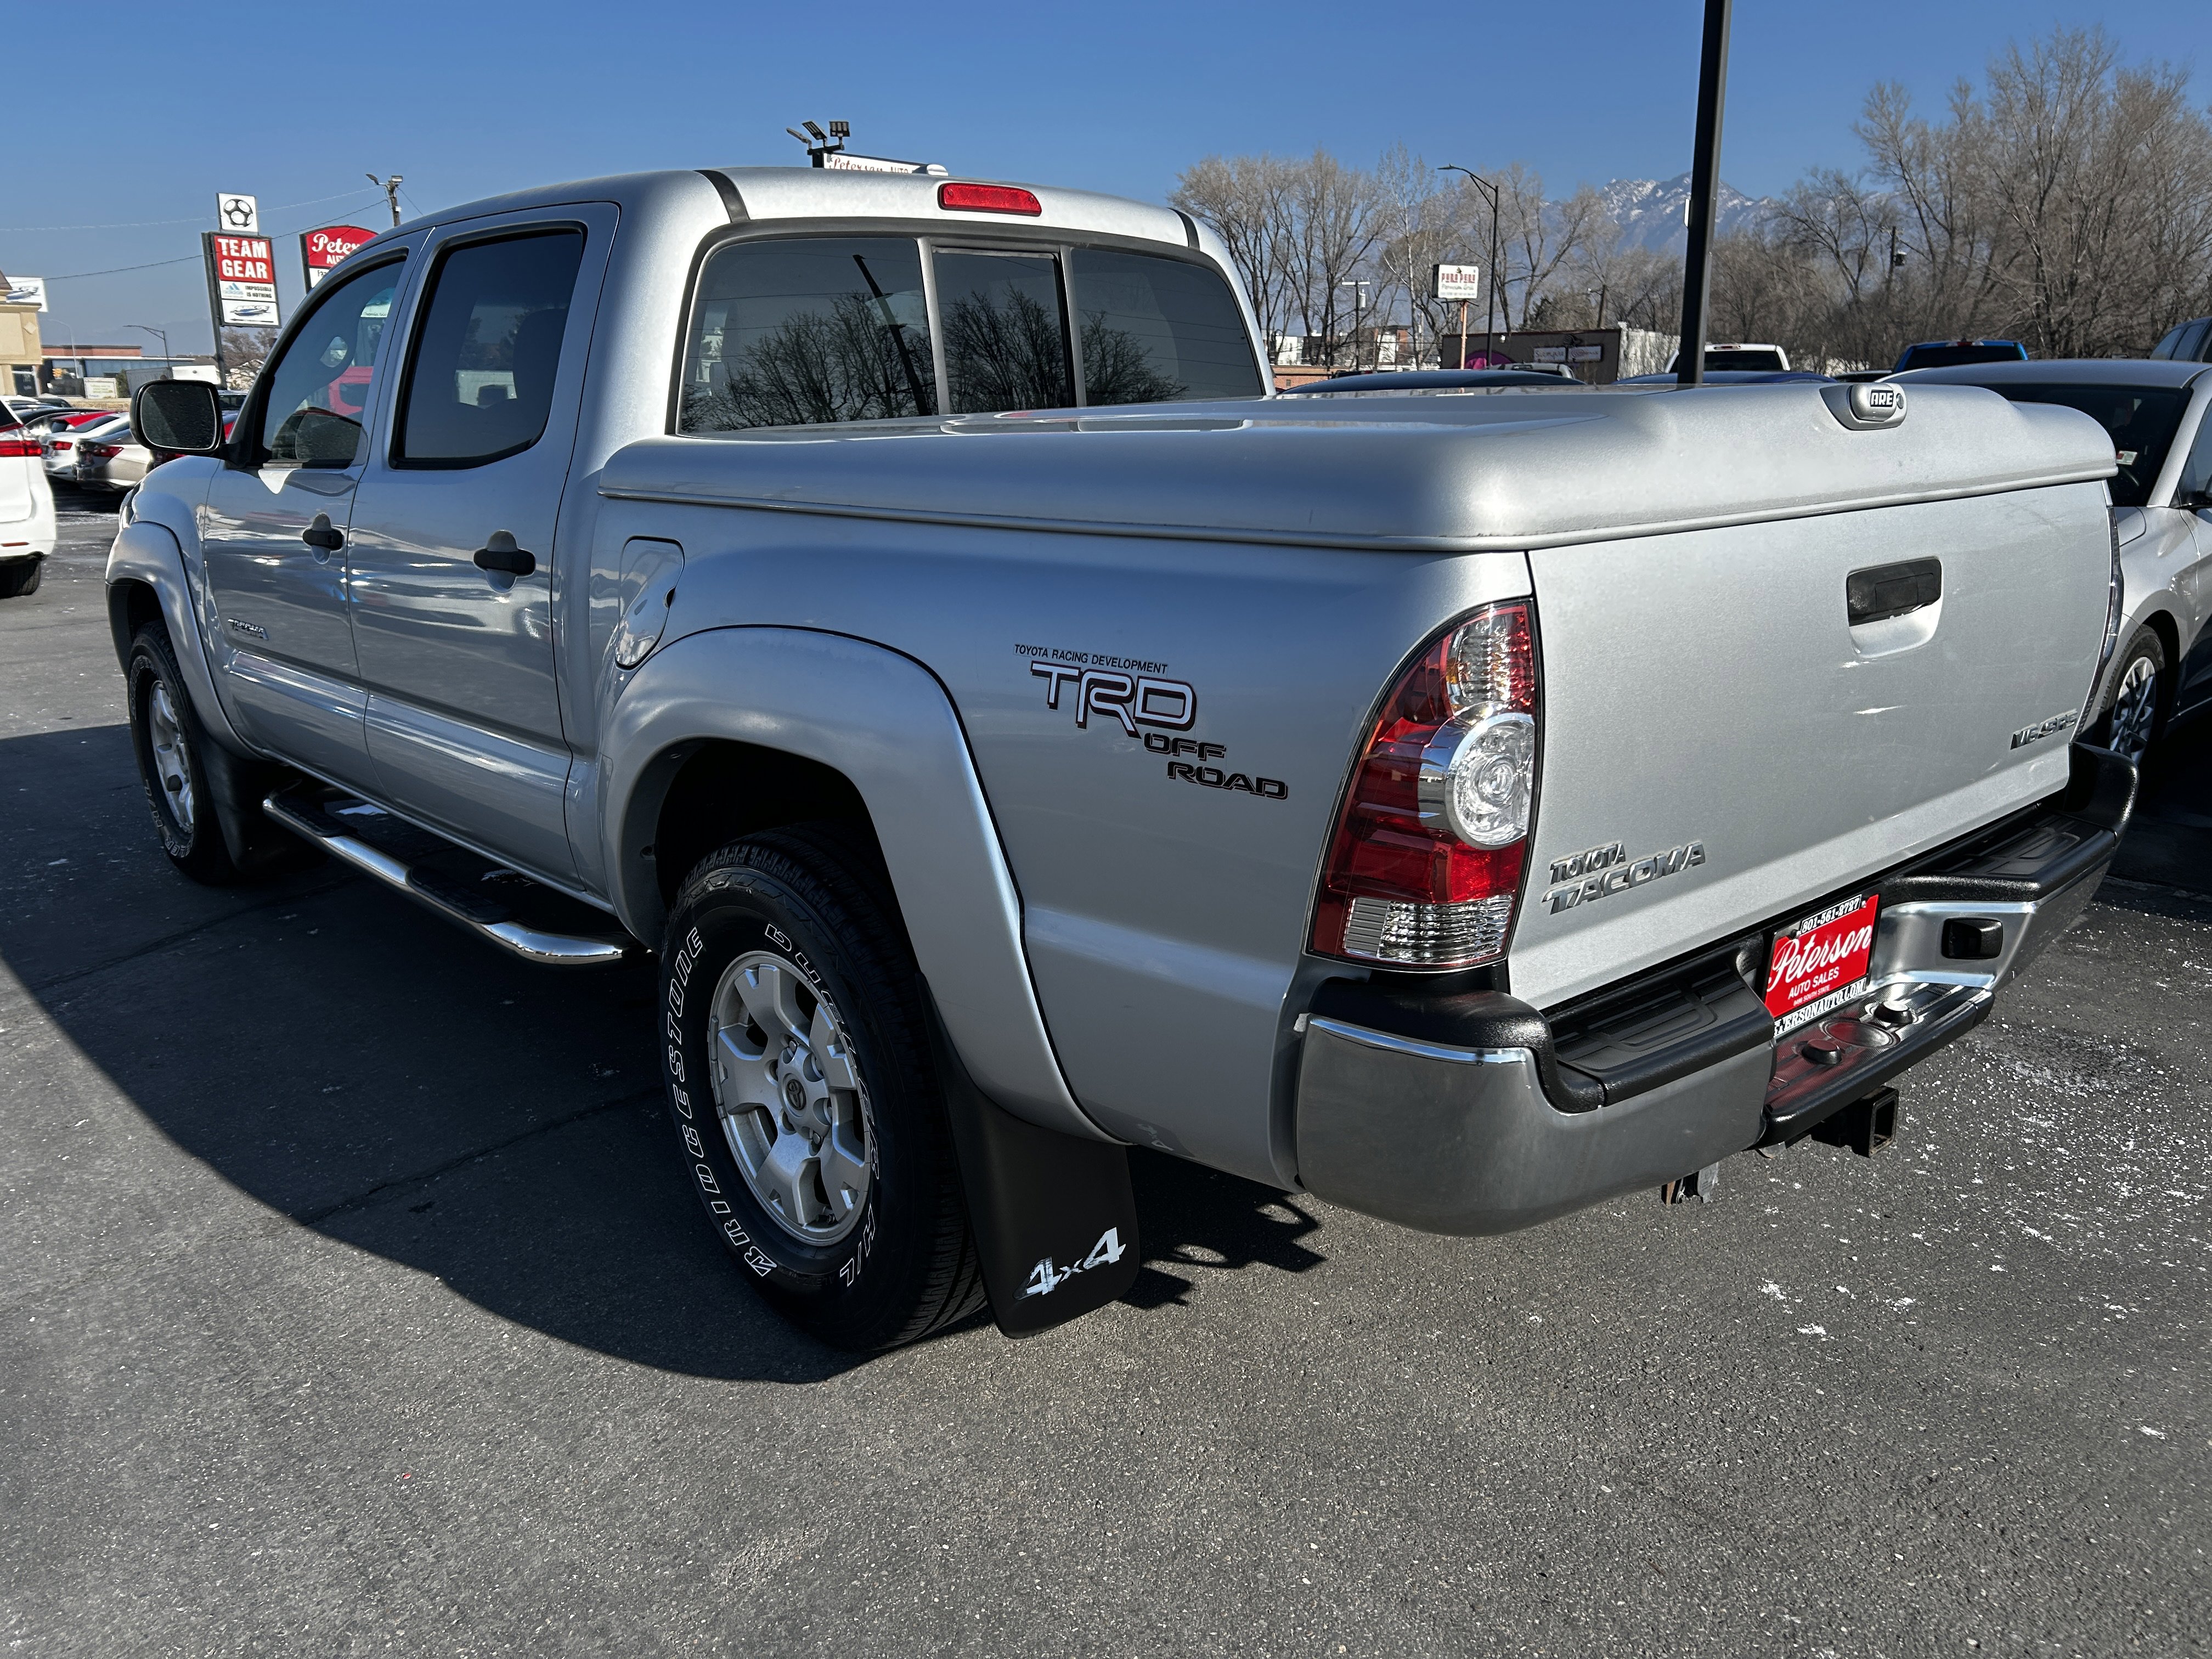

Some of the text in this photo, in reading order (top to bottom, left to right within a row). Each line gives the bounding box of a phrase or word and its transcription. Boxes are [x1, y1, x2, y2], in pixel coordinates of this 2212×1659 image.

[217, 238, 267, 258] TEAM
[221, 259, 268, 279] GEAR
[1870, 392, 1894, 405] ARE
[1014, 644, 1168, 675] TOYOTA RACING DEVELOPMENT
[1030, 660, 1198, 740] TRD
[1144, 732, 1227, 761] OFF
[1167, 761, 1288, 800] ROAD
[1542, 843, 1706, 915] TACOMA
[1550, 843, 1627, 885] TOYOTA
[1767, 924, 1872, 992] Peterson
[1787, 966, 1840, 1000] AUTO SALES
[667, 927, 778, 1277] BRIDGESTONE
[1013, 1227, 1126, 1301] 4x4
